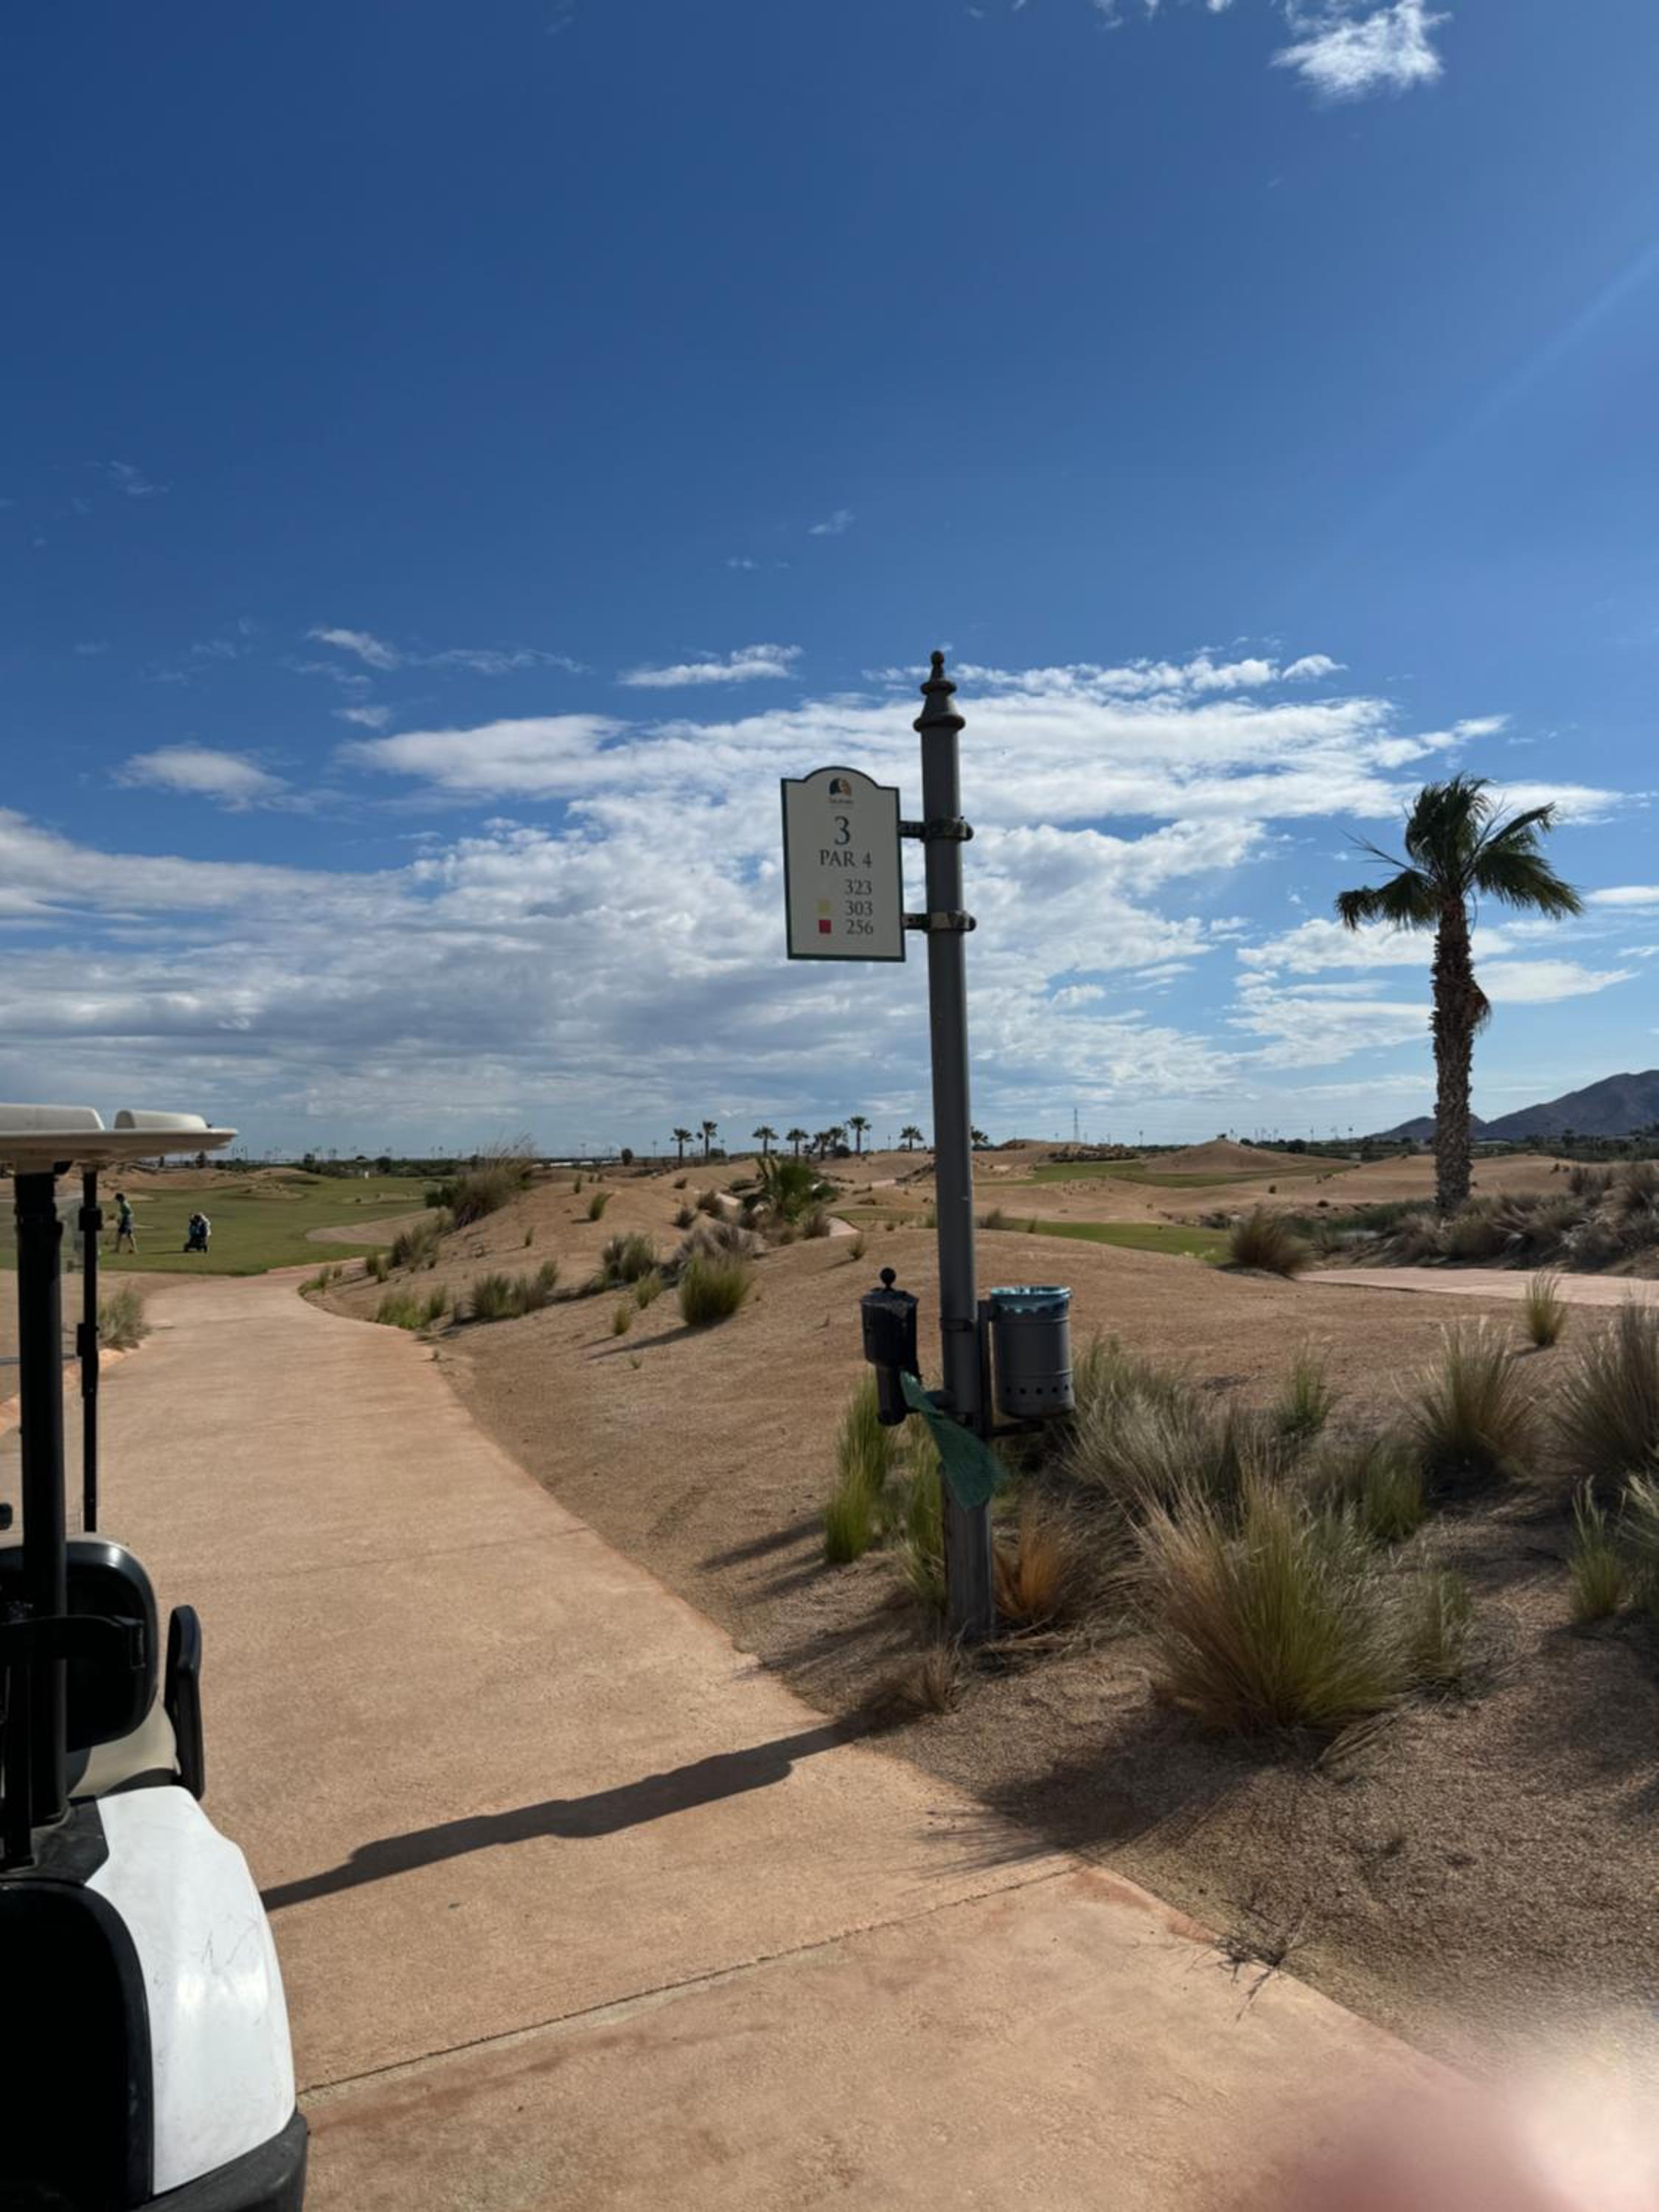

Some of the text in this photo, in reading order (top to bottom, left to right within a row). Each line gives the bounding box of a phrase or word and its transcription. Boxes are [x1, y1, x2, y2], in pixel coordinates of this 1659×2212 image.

[834, 815, 851, 846] 3
[819, 849, 872, 869] PAR 4
[844, 879, 872, 895] 323
[845, 900, 873, 917] 303
[846, 919, 874, 935] 256
